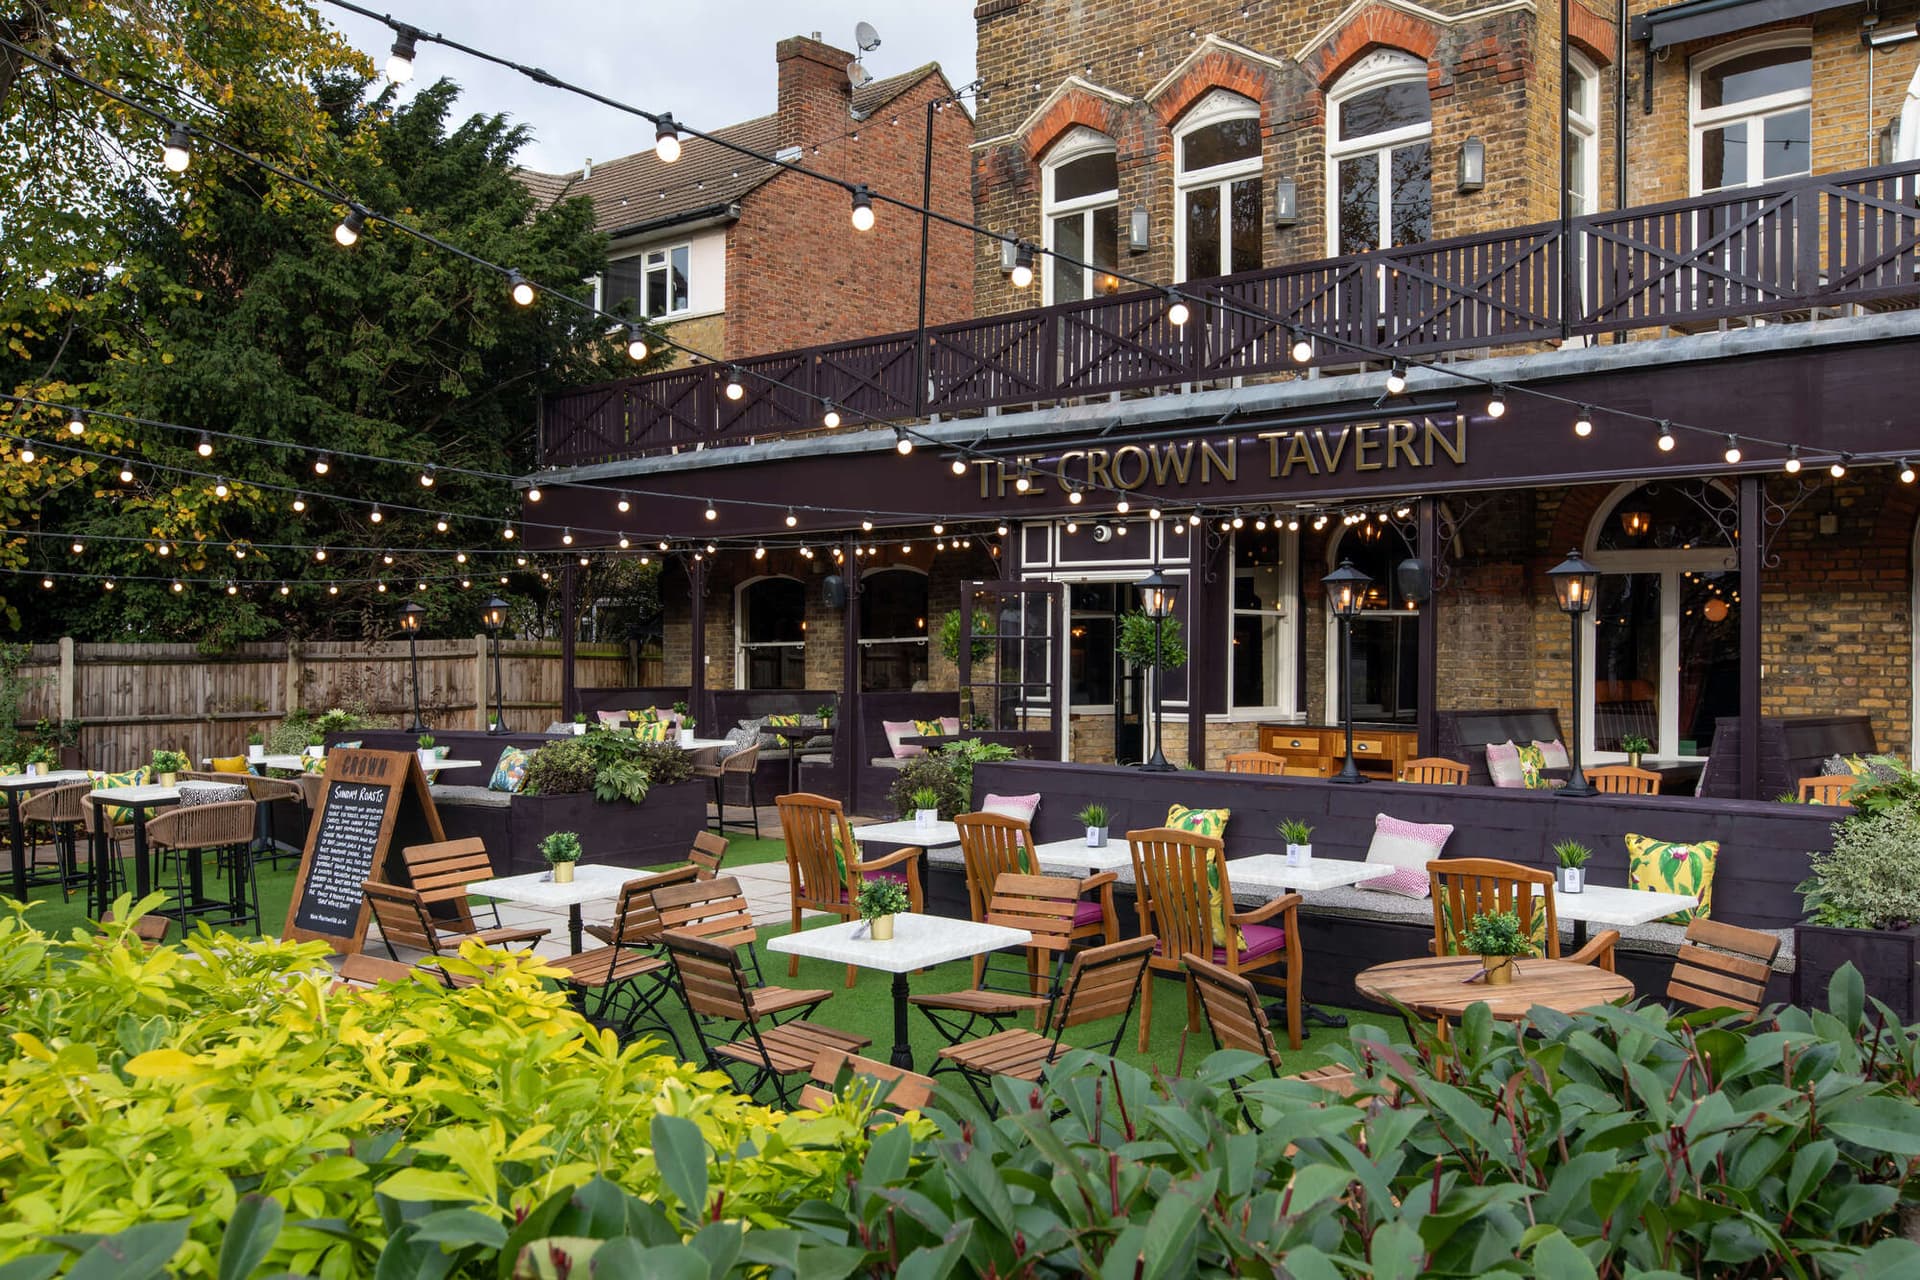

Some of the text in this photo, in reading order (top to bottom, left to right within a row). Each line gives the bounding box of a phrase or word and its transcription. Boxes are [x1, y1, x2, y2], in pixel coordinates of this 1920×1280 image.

[971, 414, 1468, 499] THE CROWN TAVERN
[341, 755, 388, 777] CROWN
[359, 786, 384, 802] ROASTS
